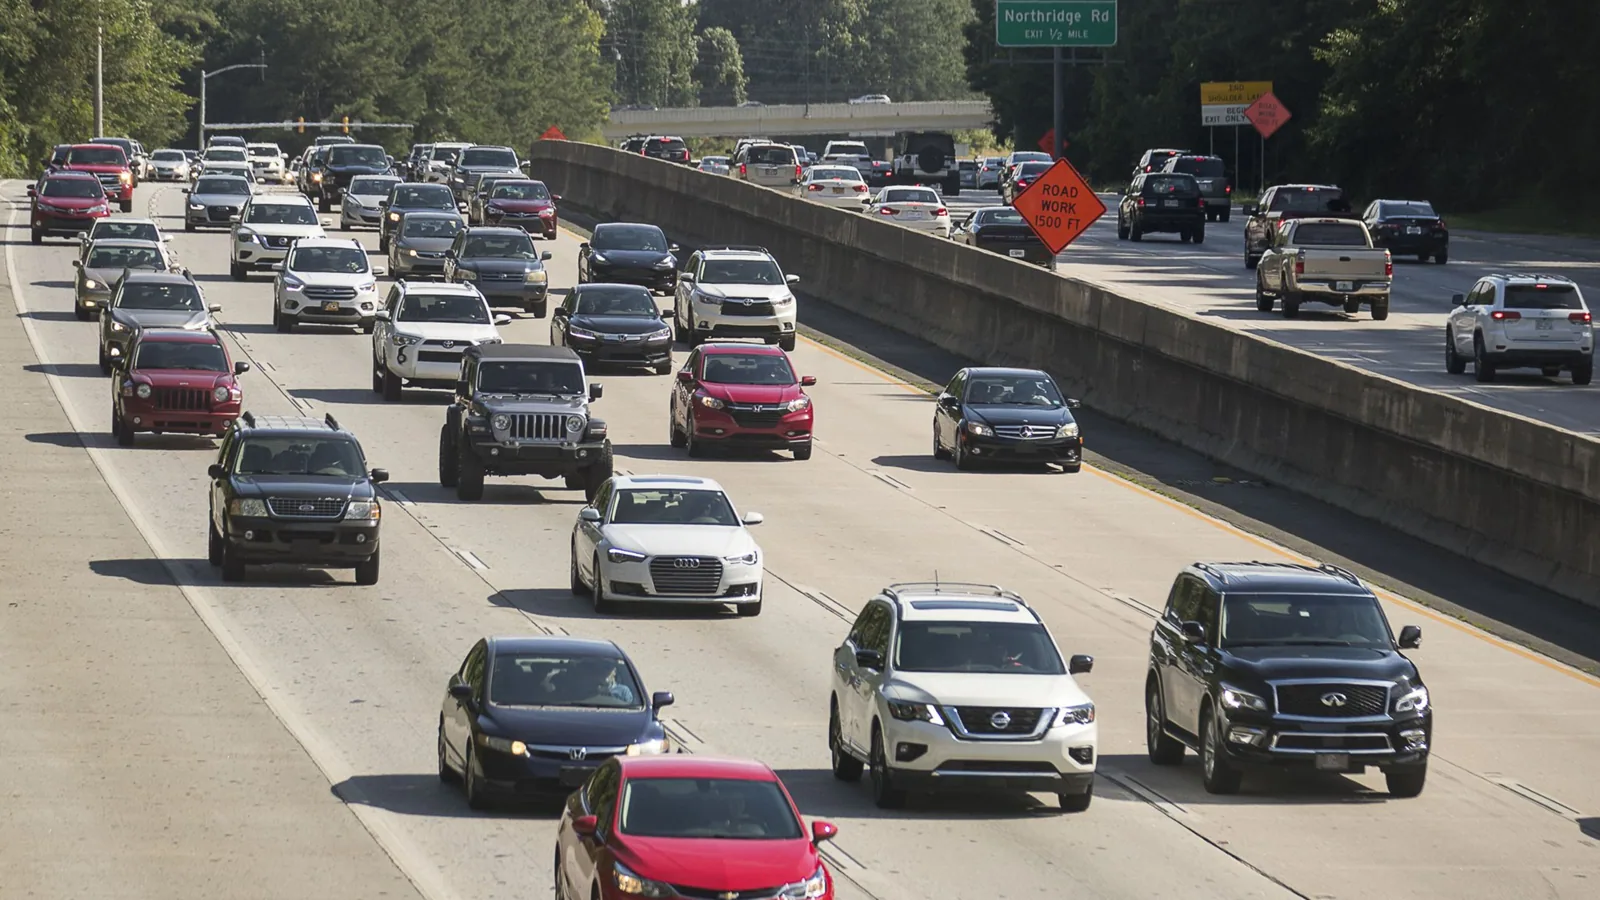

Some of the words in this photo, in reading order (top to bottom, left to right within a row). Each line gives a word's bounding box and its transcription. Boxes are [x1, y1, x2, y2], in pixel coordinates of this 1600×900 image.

[1005, 9, 1081, 25] Northridge
[1091, 9, 1109, 22] Rd
[1025, 30, 1043, 38] EXIT
[1068, 30, 1088, 38] MILE
[1208, 94, 1242, 102] SHOULDER
[1225, 115, 1245, 123] ONLY
[1042, 184, 1078, 198] ROAD
[1041, 200, 1076, 214] WORK
[1035, 215, 1061, 228] 1500
[1068, 218, 1080, 230] FT
